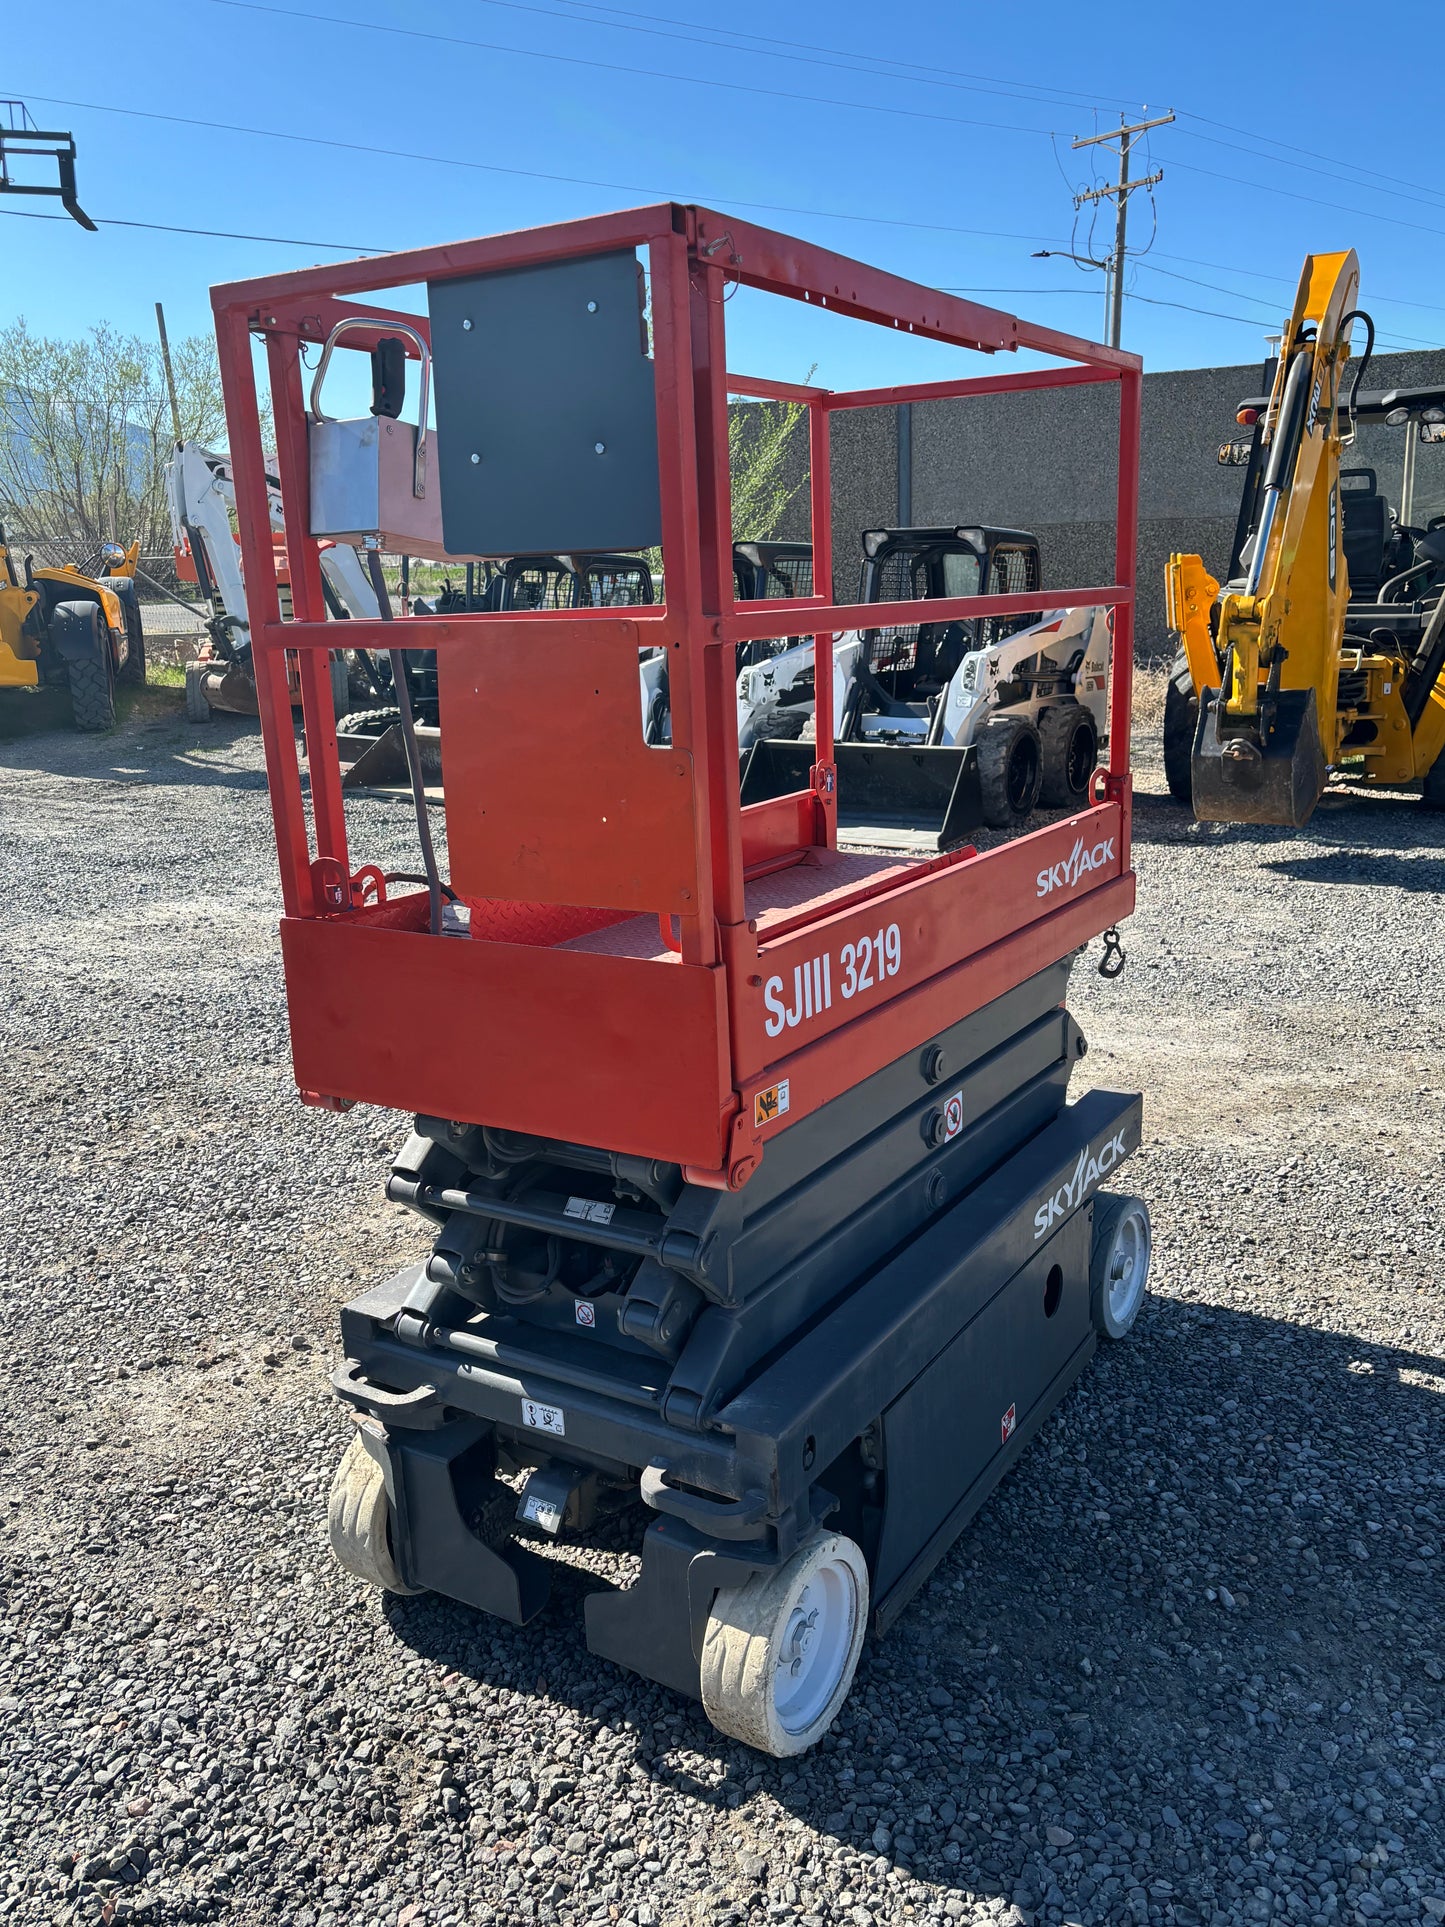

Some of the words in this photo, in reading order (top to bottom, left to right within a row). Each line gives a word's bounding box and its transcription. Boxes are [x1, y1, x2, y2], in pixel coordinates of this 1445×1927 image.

[1306, 381, 1321, 435] 3CX
[1036, 836, 1115, 897] SKYJACK
[764, 952, 832, 1037] SJIII
[840, 923, 901, 999] 3219
[1034, 1127, 1126, 1240] SKYJACK
